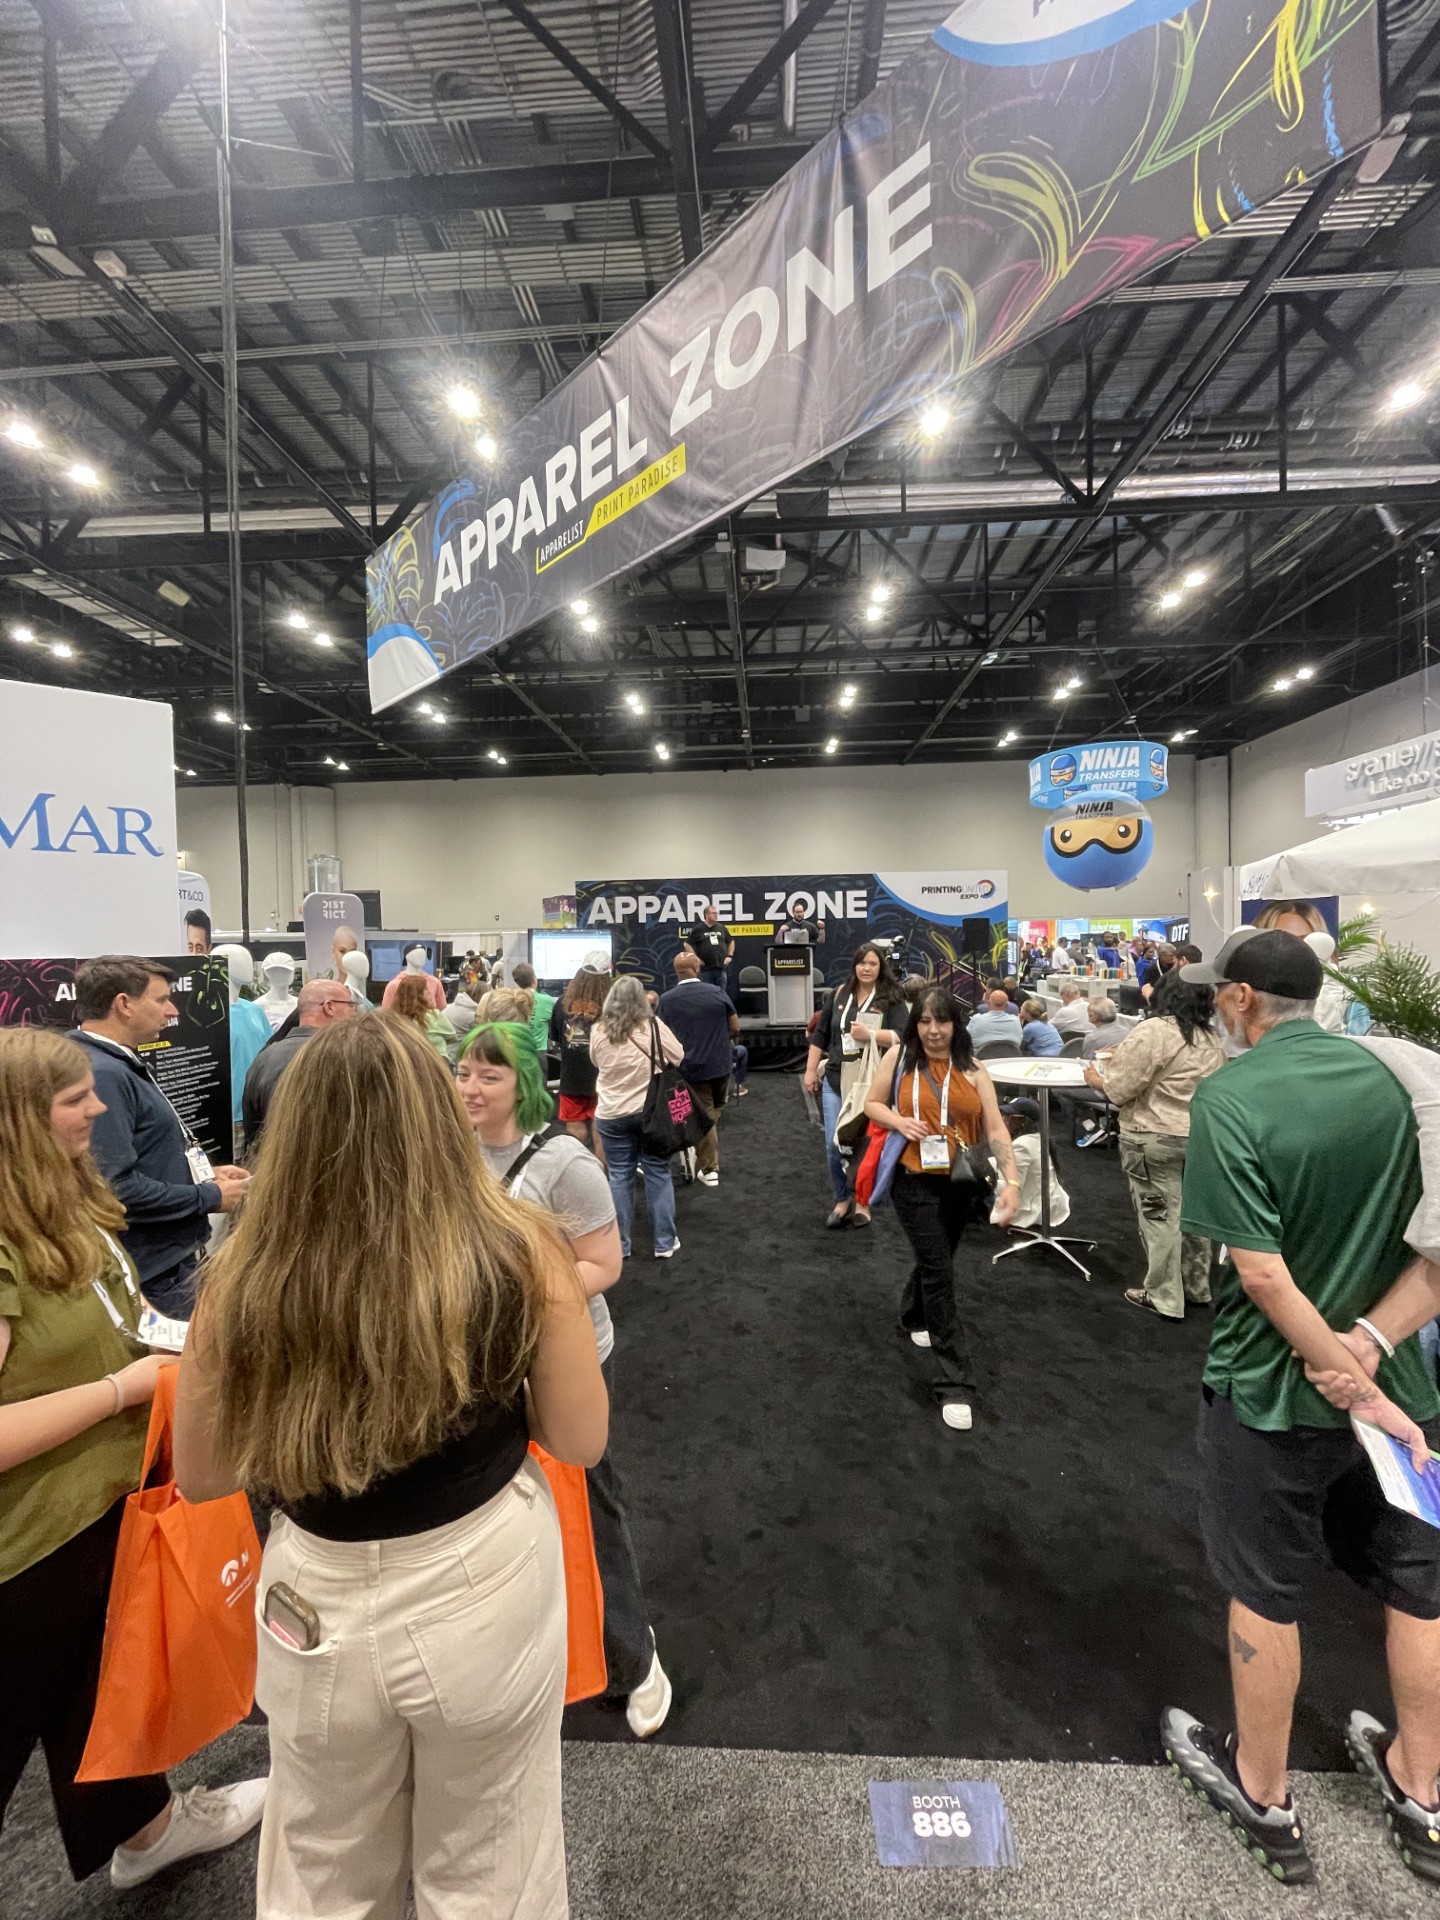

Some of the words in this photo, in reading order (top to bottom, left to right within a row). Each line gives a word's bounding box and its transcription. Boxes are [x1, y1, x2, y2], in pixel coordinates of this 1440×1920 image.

[434, 395, 647, 605] APPAREL
[670, 141, 932, 436] ZONE
[540, 520, 584, 564] APPARELIST
[597, 493, 624, 524] PRINT
[629, 455, 678, 503] PARADISE
[1079, 746, 1140, 772] NINJA
[1080, 769, 1140, 782] TRANSFERS
[1075, 801, 1114, 814] NINJA
[1075, 811, 1114, 820] TRANSFERS
[587, 893, 754, 924] APPAREL
[764, 890, 868, 921] ZONE
[1171, 923, 1189, 943] DTF
[171, 976, 192, 992] NE
[912, 1796, 961, 1809] BOOTH
[912, 1811, 971, 1838] 886
